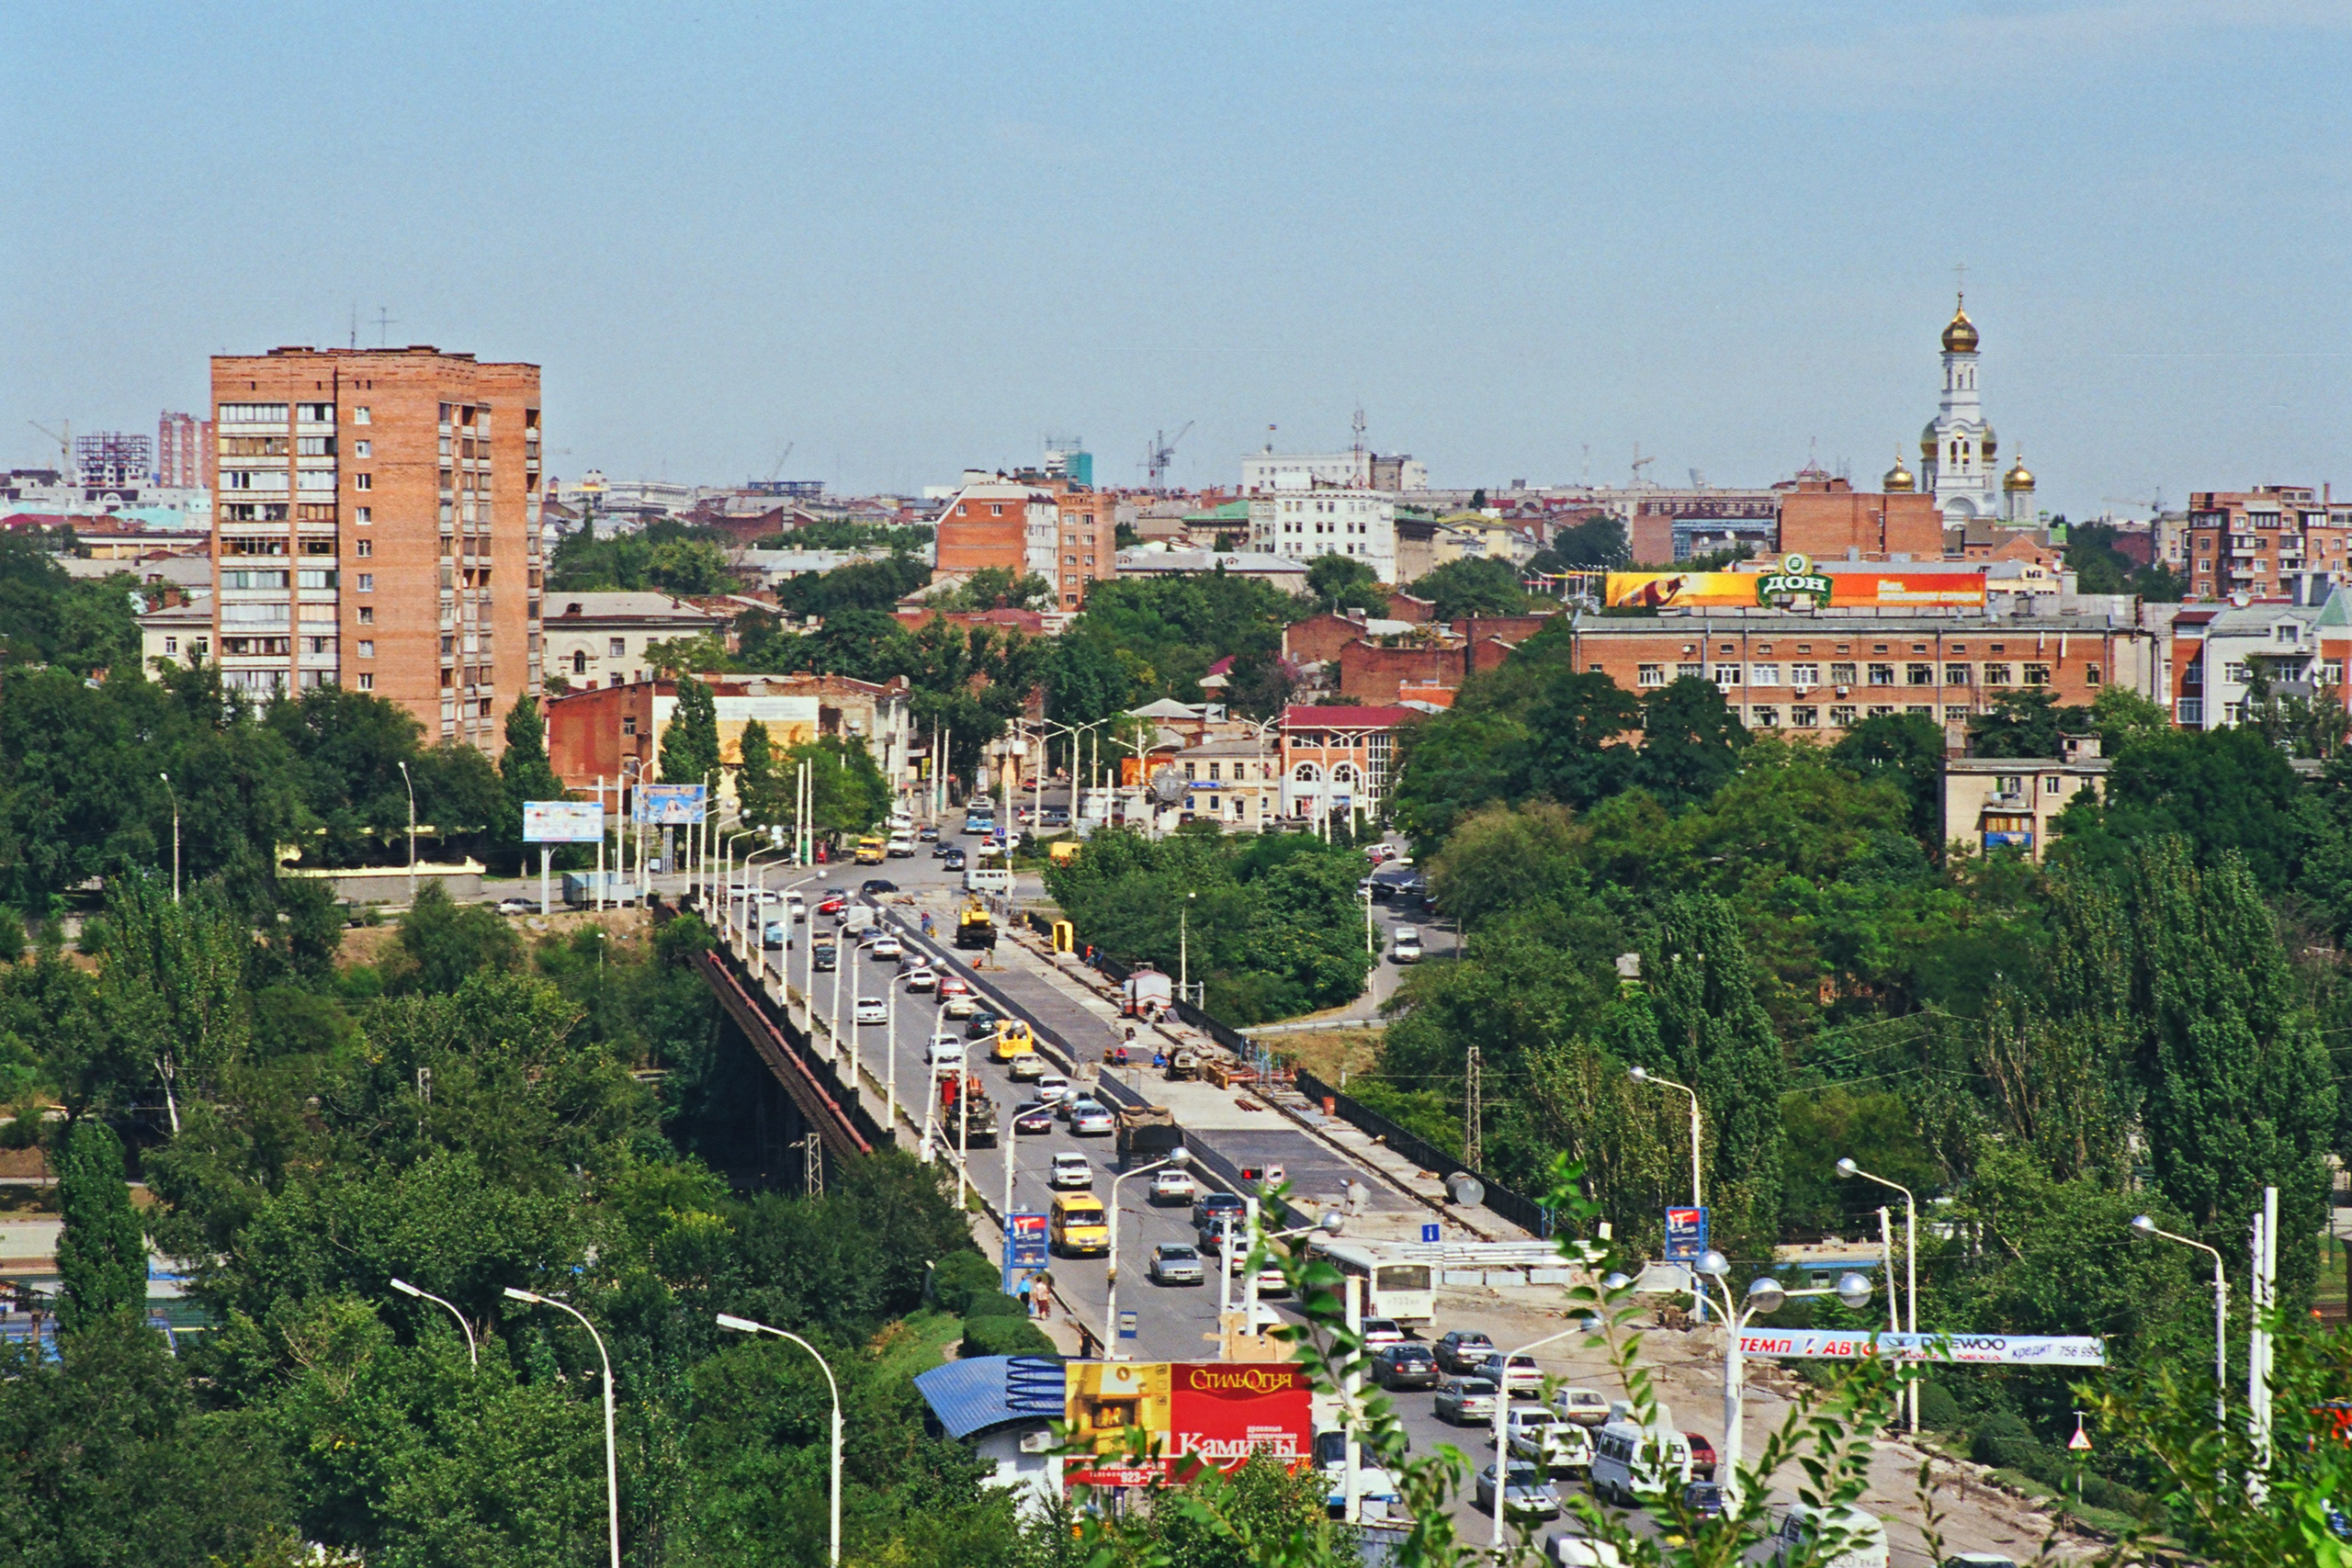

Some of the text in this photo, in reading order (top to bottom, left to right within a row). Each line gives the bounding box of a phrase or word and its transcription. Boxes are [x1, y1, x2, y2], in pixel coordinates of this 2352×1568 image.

[1763, 576, 1826, 594] ДОН
[1739, 1338, 1792, 1352] ТЕМП
[1921, 1337, 2006, 1350] DEWOO
[1121, 1472, 1166, 1483] 923-7
